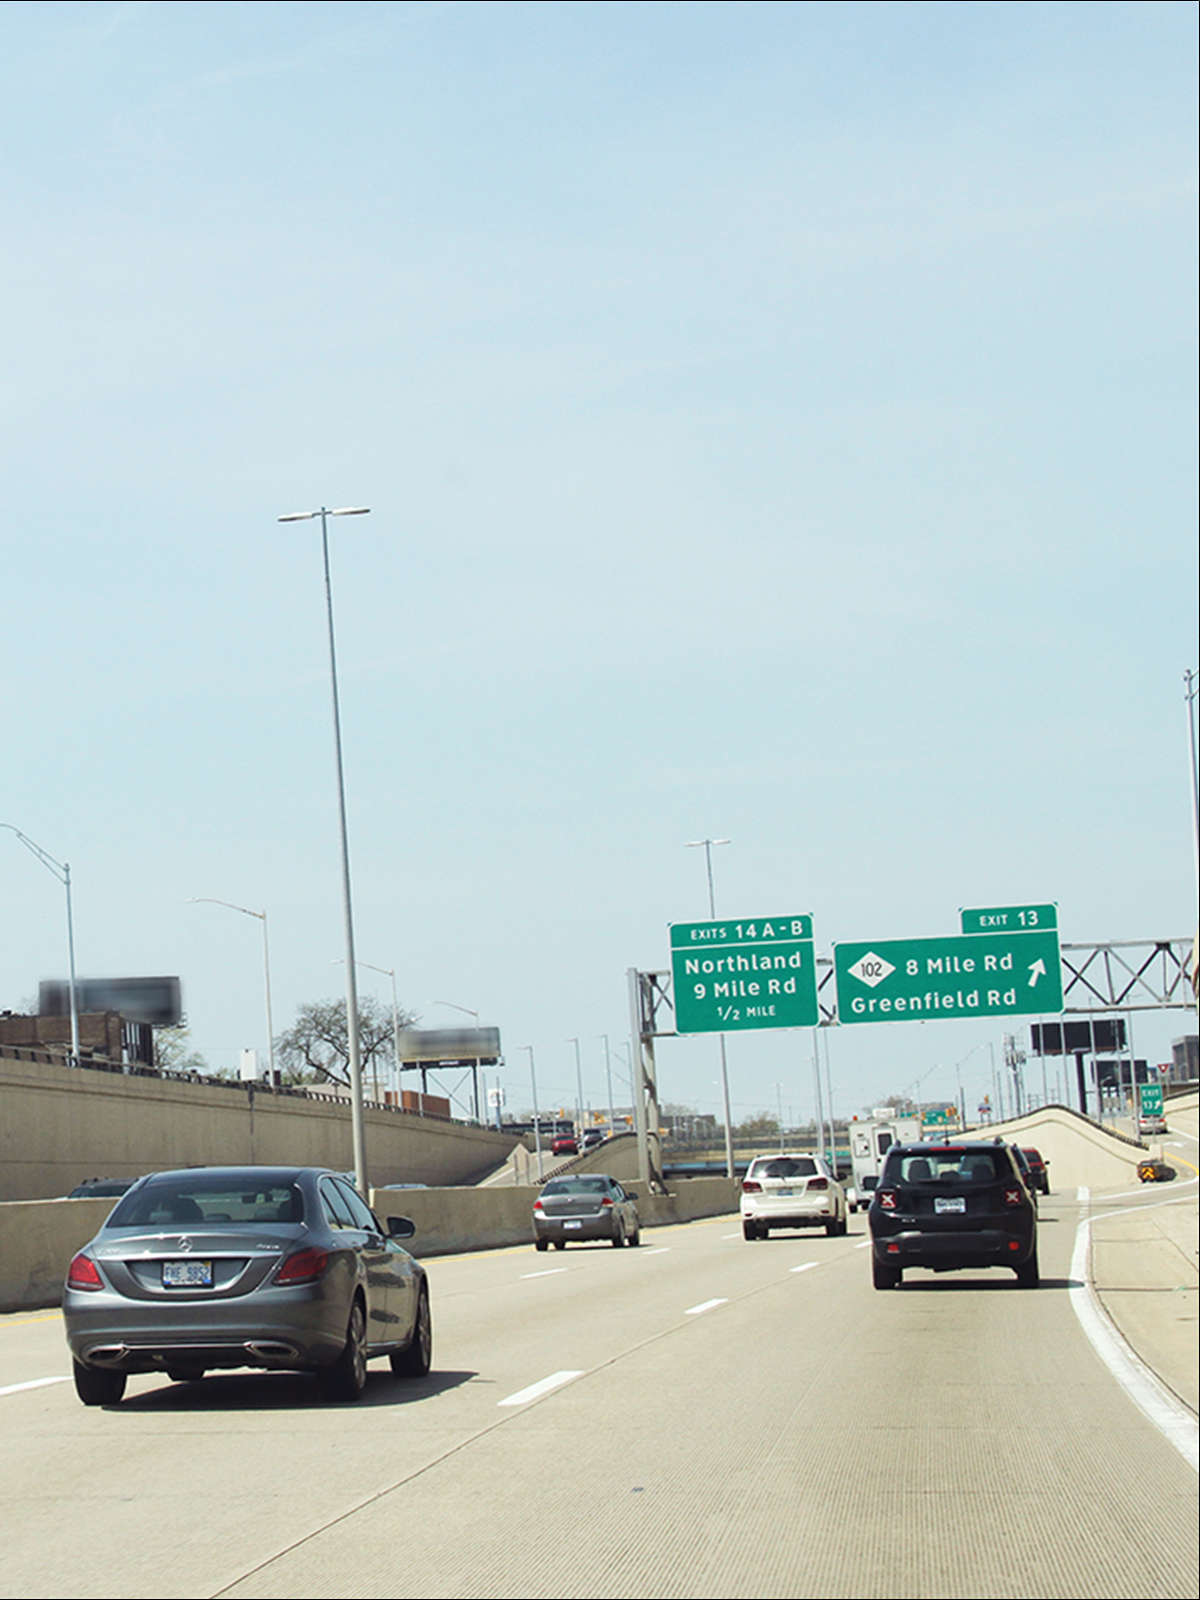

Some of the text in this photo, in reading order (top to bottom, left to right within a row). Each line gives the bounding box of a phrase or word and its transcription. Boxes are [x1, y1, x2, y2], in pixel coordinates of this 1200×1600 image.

[979, 910, 1039, 927] EXIT 13
[690, 927, 727, 940] EXITS
[685, 951, 801, 975] Northland
[860, 961, 883, 977] 102
[905, 952, 1013, 976] 8 Mile Rd
[693, 977, 797, 1000] 9 Mile Rd
[851, 988, 1017, 1014] Greenfield Rd
[717, 1005, 776, 1020] 1/2 MILE
